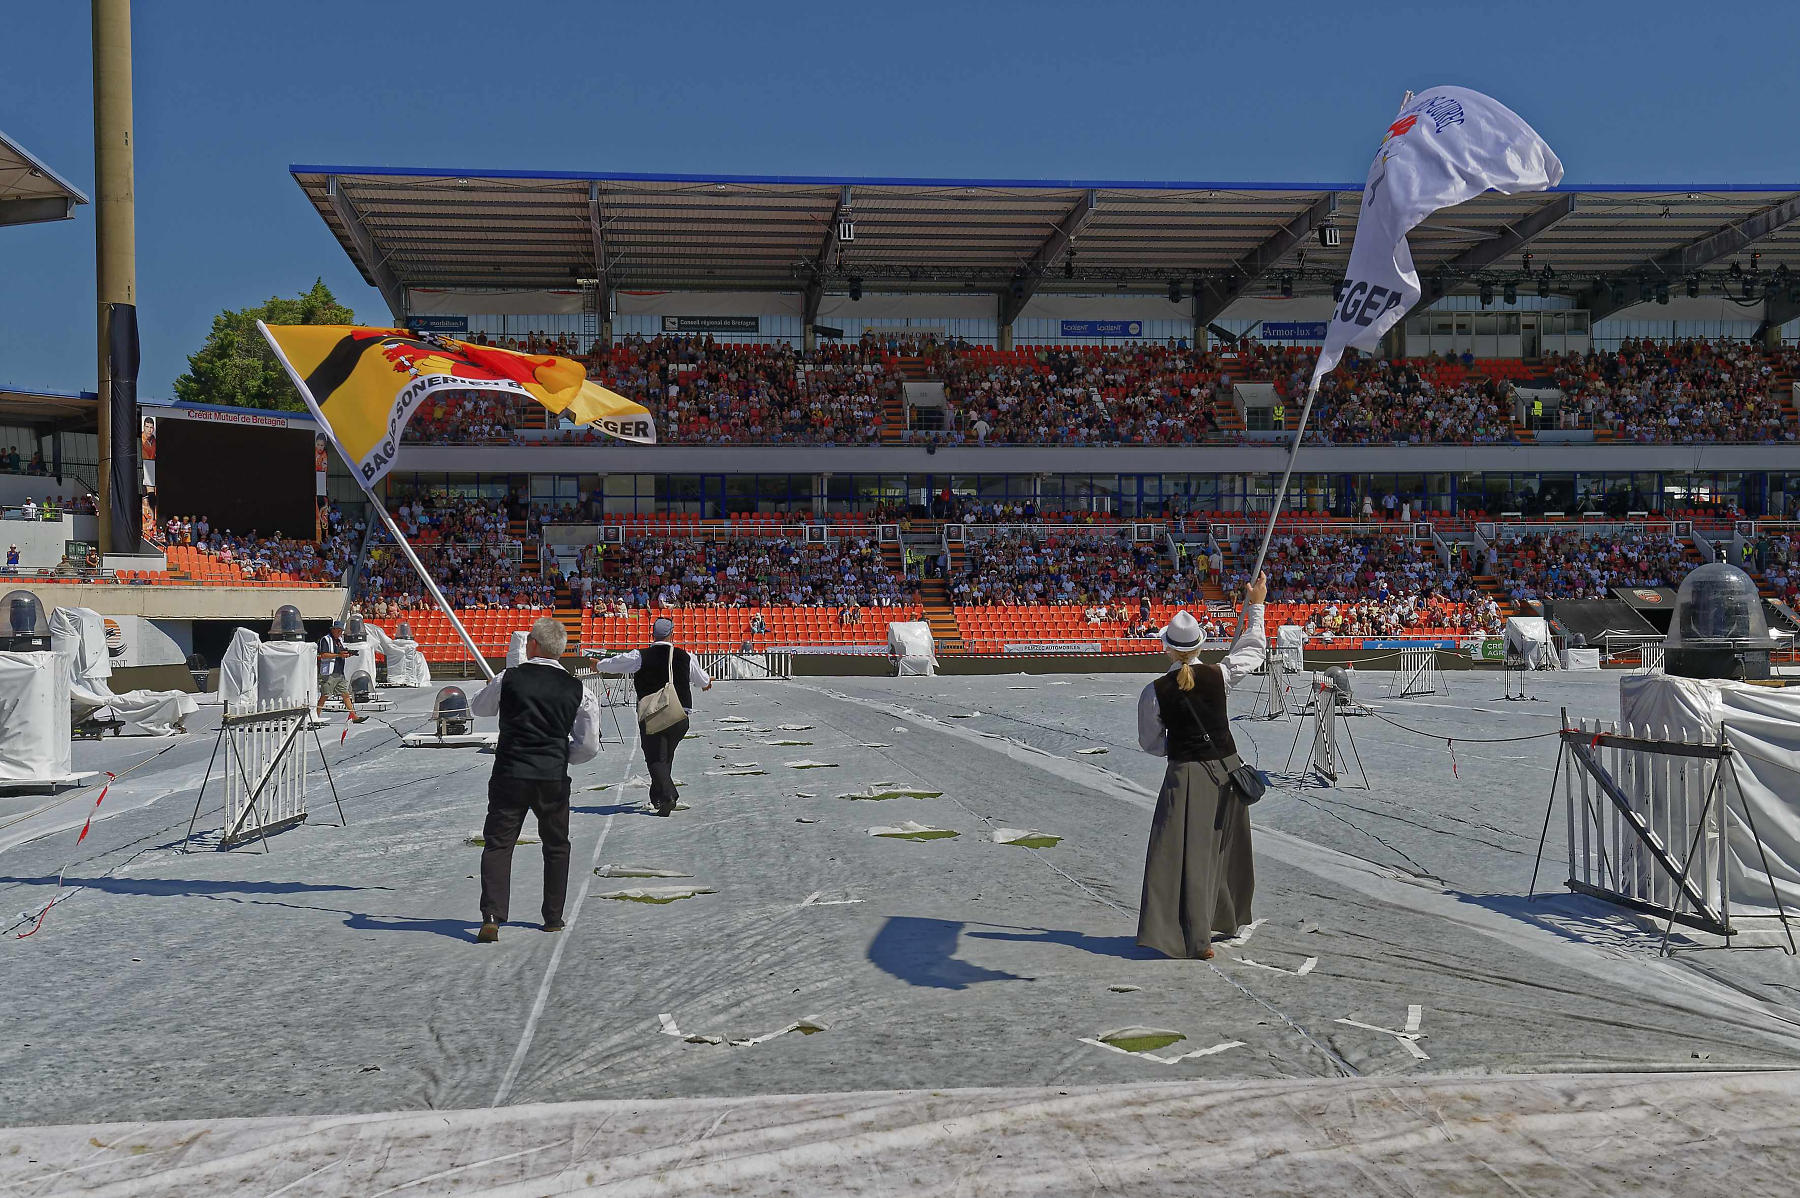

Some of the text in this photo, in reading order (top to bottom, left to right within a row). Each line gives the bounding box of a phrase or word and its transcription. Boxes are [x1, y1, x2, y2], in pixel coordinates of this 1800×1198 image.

[732, 319, 756, 328] Bretagne
[188, 408, 285, 427] Crédit Mutuel de Bretagne
